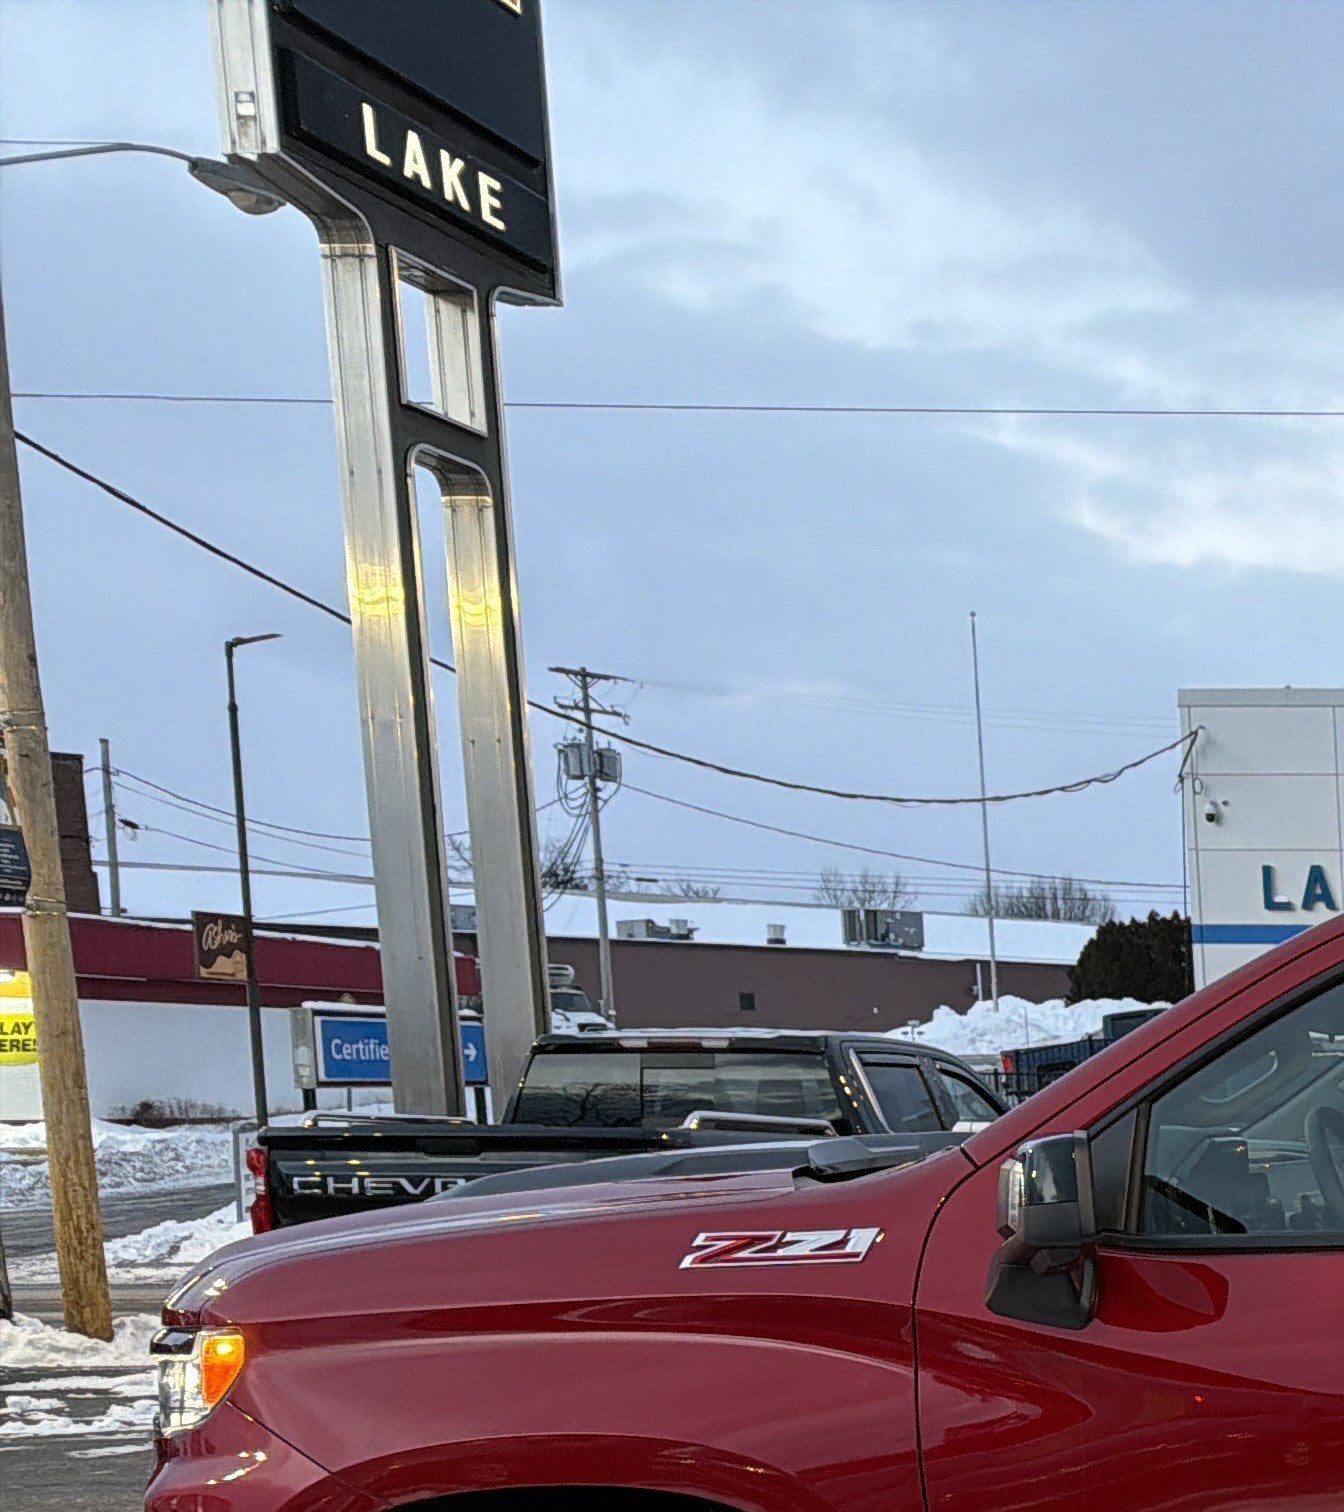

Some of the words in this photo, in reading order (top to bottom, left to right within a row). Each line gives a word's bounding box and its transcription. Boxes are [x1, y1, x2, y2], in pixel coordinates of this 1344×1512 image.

[362, 102, 507, 232] LAKE
[0, 1021, 34, 1036] LAY
[0, 1038, 37, 1053] ERE!
[331, 1039, 390, 1061] Certifie
[292, 1176, 466, 1196] CHEVR
[679, 1227, 880, 1270] Z71
